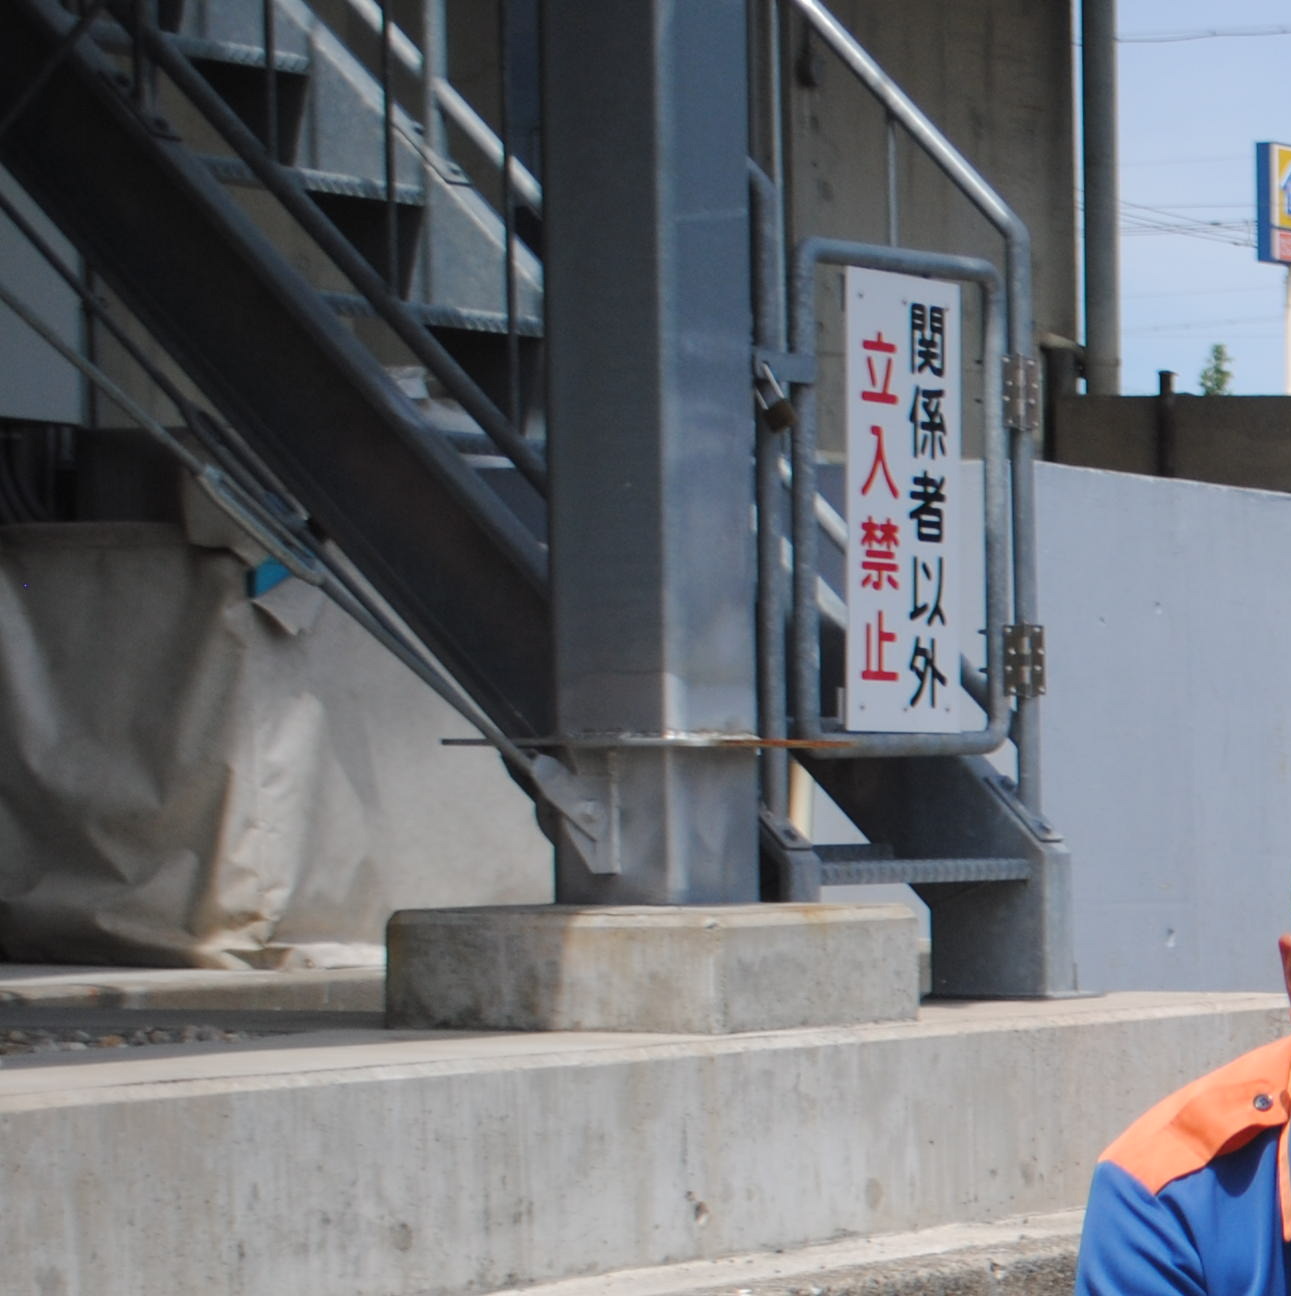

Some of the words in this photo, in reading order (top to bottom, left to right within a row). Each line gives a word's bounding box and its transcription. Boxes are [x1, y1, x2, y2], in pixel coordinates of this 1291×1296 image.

[861, 332, 899, 681] 立入禁止
[909, 304, 946, 707] 関係者以外
